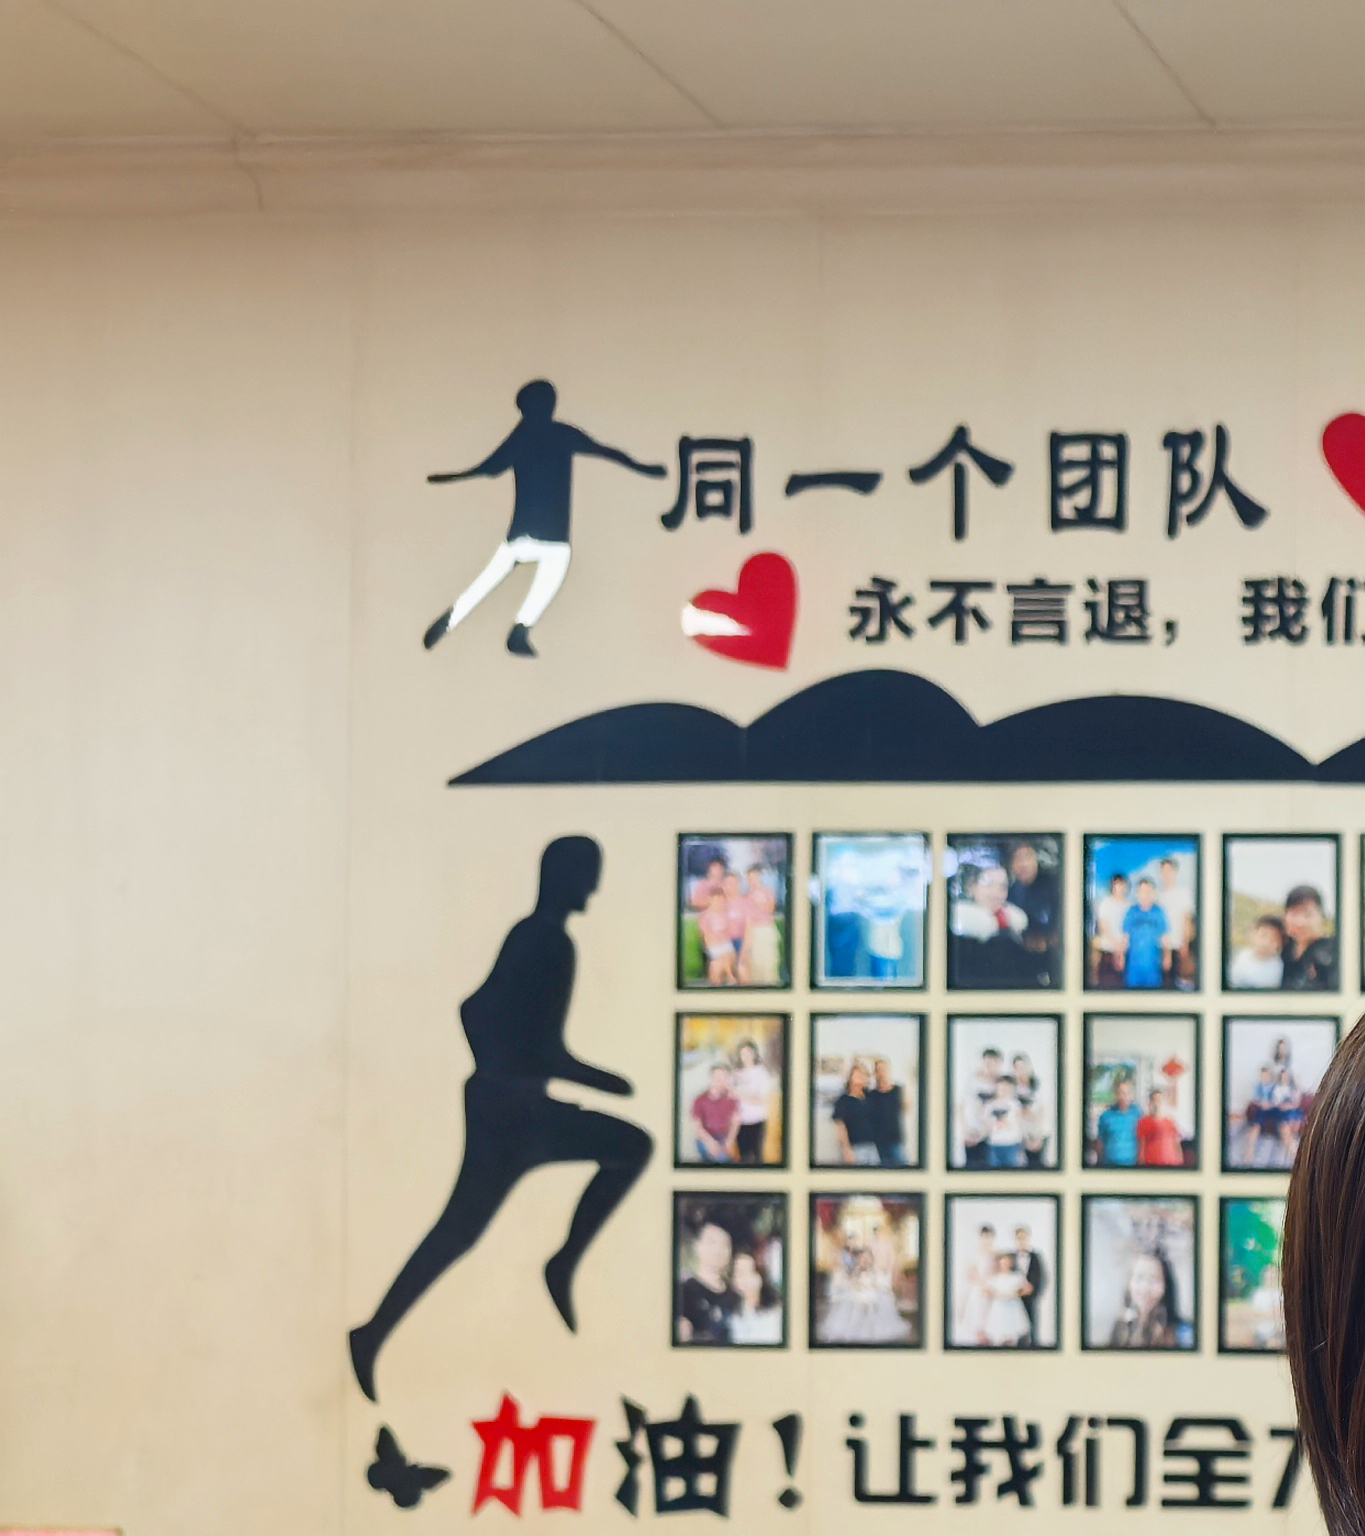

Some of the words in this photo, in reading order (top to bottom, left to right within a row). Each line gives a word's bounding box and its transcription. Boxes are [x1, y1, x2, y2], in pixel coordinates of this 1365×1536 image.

[660, 422, 1269, 541] 同一个团队
